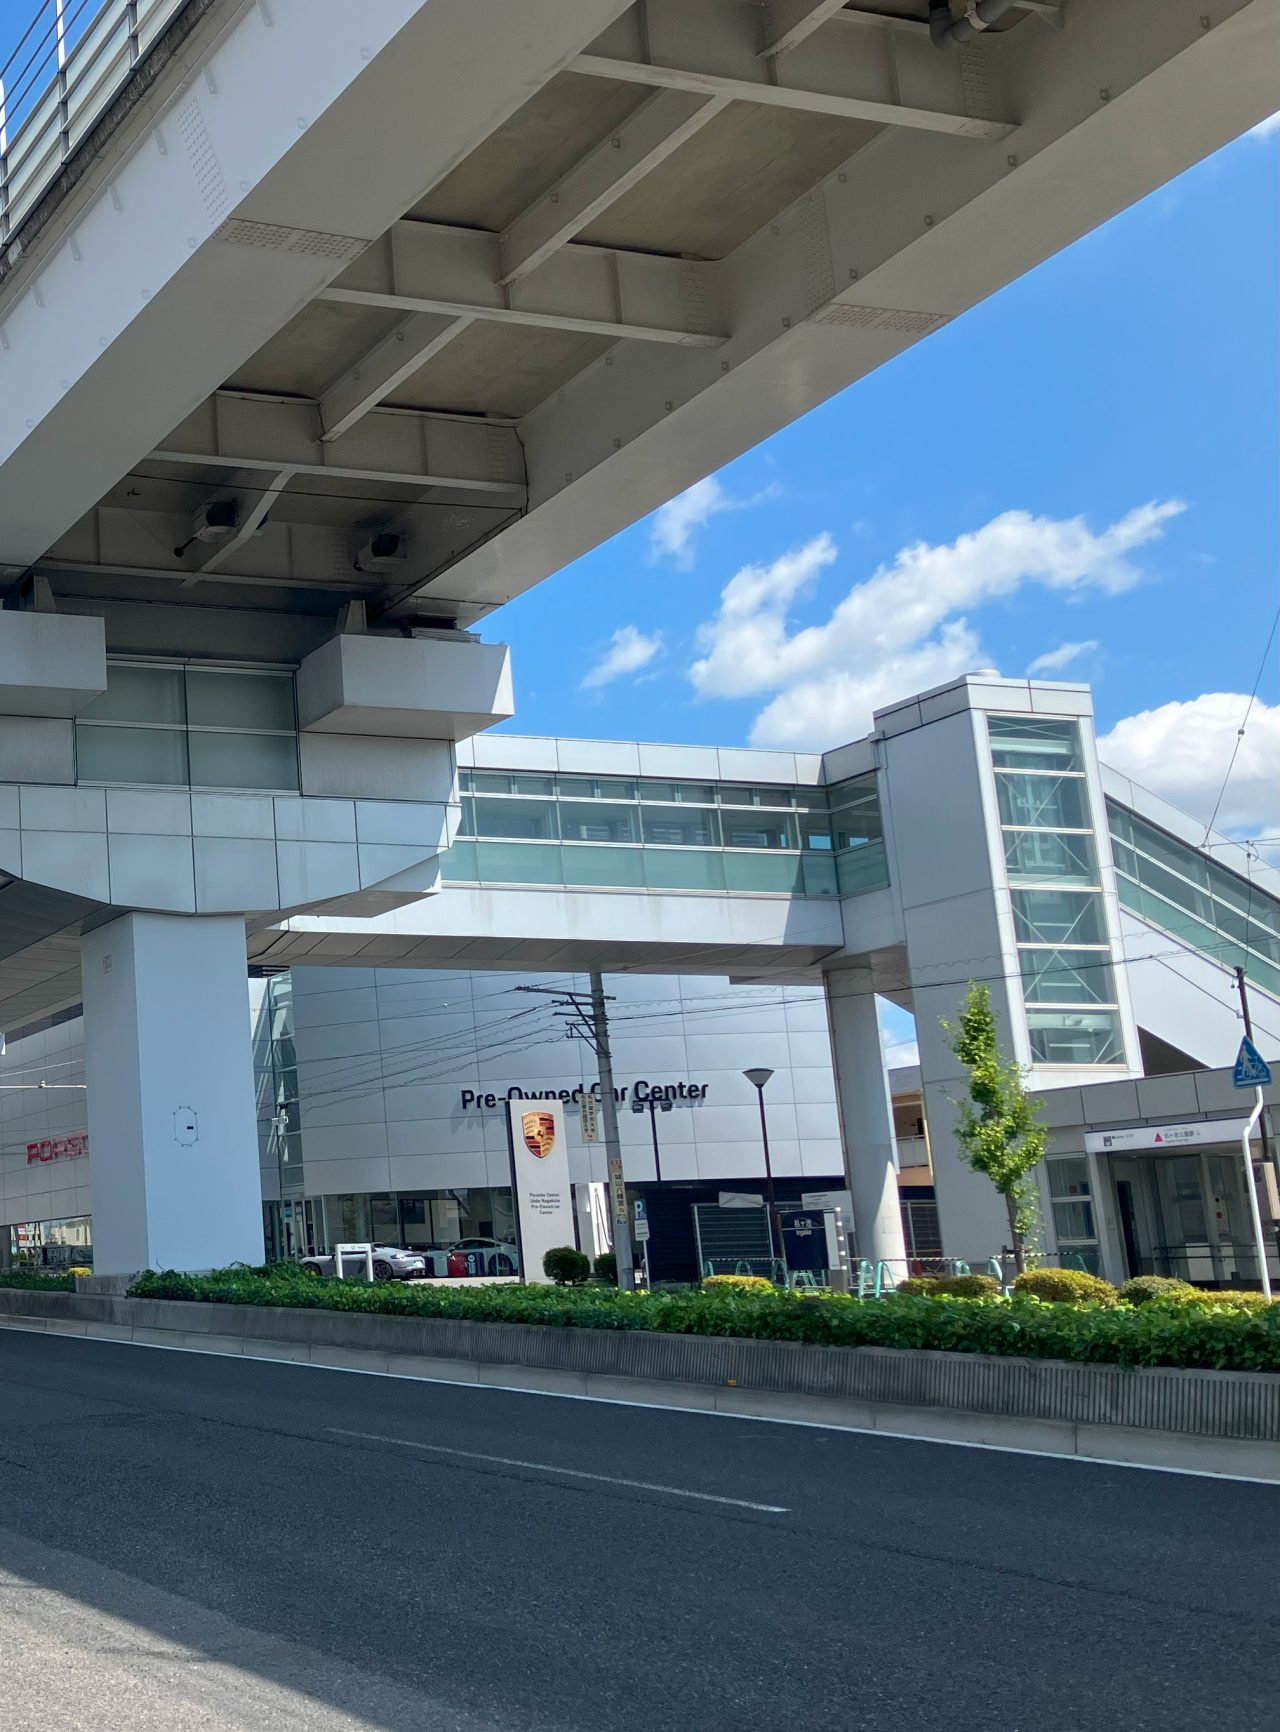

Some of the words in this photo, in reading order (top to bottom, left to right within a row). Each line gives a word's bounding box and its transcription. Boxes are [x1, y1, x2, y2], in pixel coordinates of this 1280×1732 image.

[461, 1083, 584, 1110] Pre-Owned
[634, 1080, 709, 1102] Center
[634, 1200, 643, 1219] P
